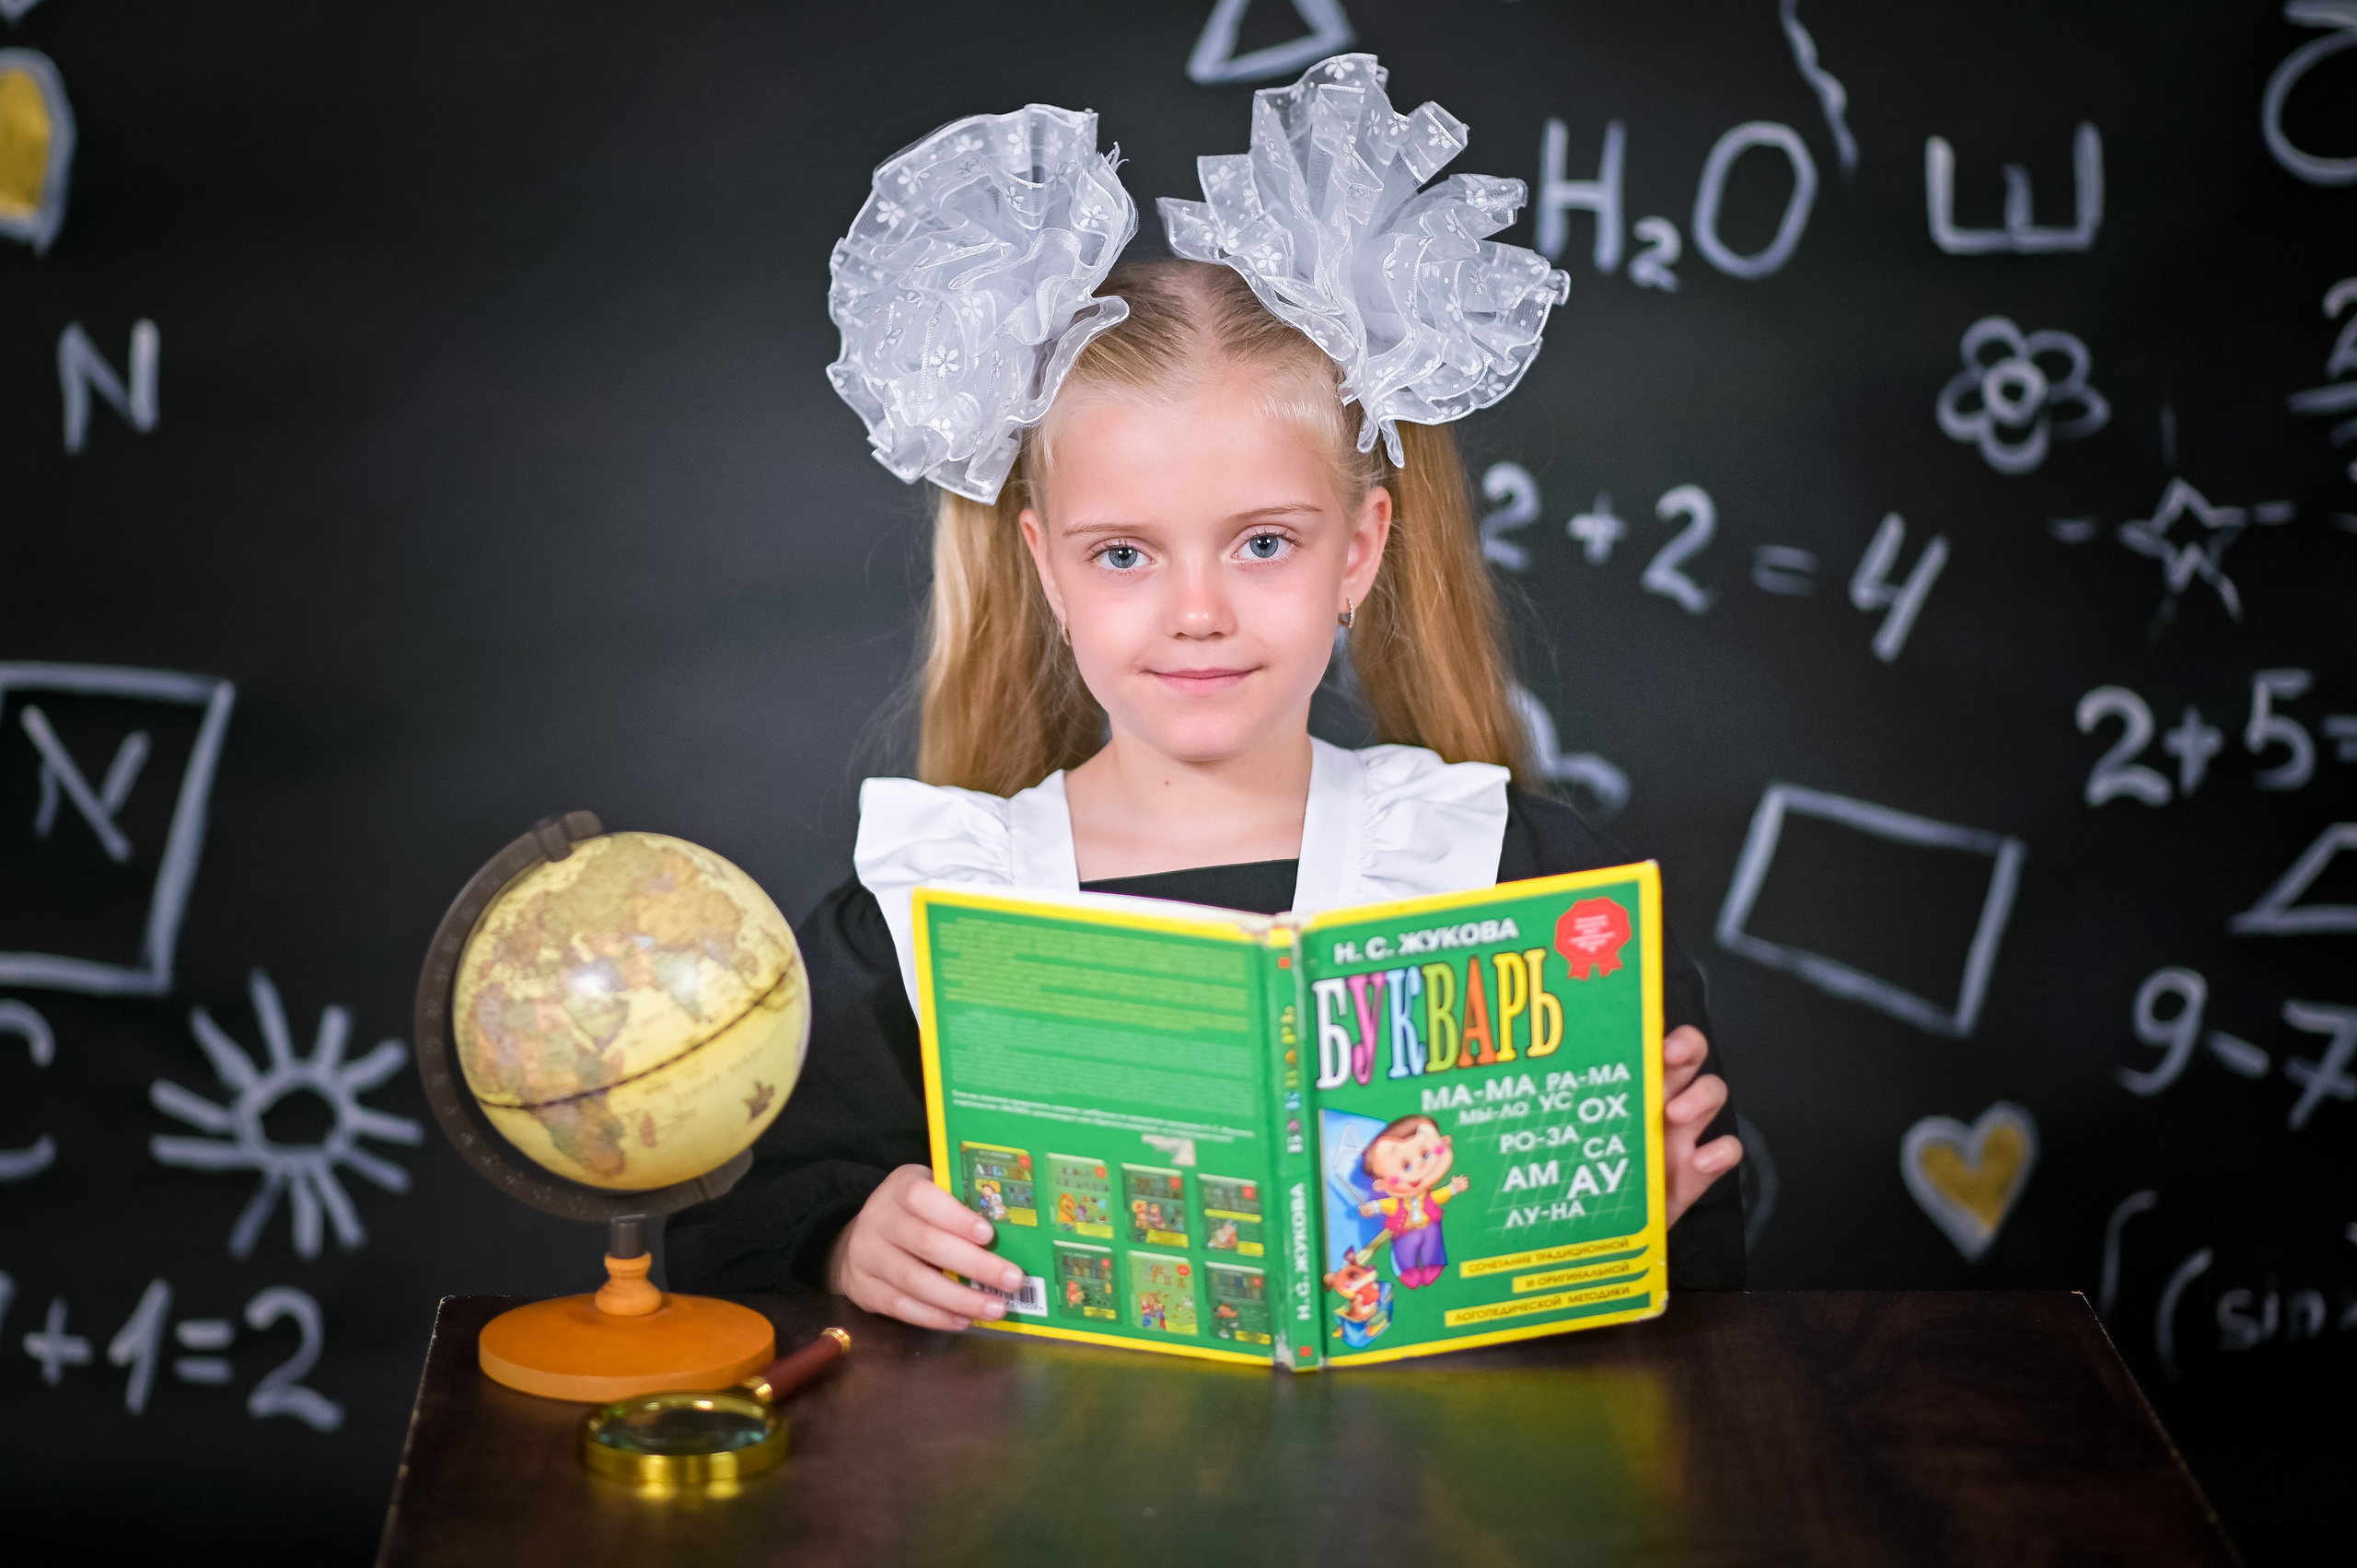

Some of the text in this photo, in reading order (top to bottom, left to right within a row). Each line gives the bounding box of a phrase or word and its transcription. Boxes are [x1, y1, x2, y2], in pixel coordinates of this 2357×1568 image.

[58, 318, 161, 455] N
[1333, 917, 1520, 965] Н. С. ЖУКОВА
[1312, 947, 1563, 1090] БУКВАРЬ
[1421, 1063, 1631, 1111] МА-МА РА-МА
[1538, 1091, 1573, 1113] УС
[1577, 1093, 1629, 1124] ОХ
[1499, 1126, 1580, 1154] РО-ЗА
[1583, 1135, 1626, 1159] СА
[1503, 1157, 1629, 1198] АМ АУ
[1504, 1201, 1586, 1229] ЛУ-НА
[1568, 1285, 1631, 1304] МЕТОДИКИ
